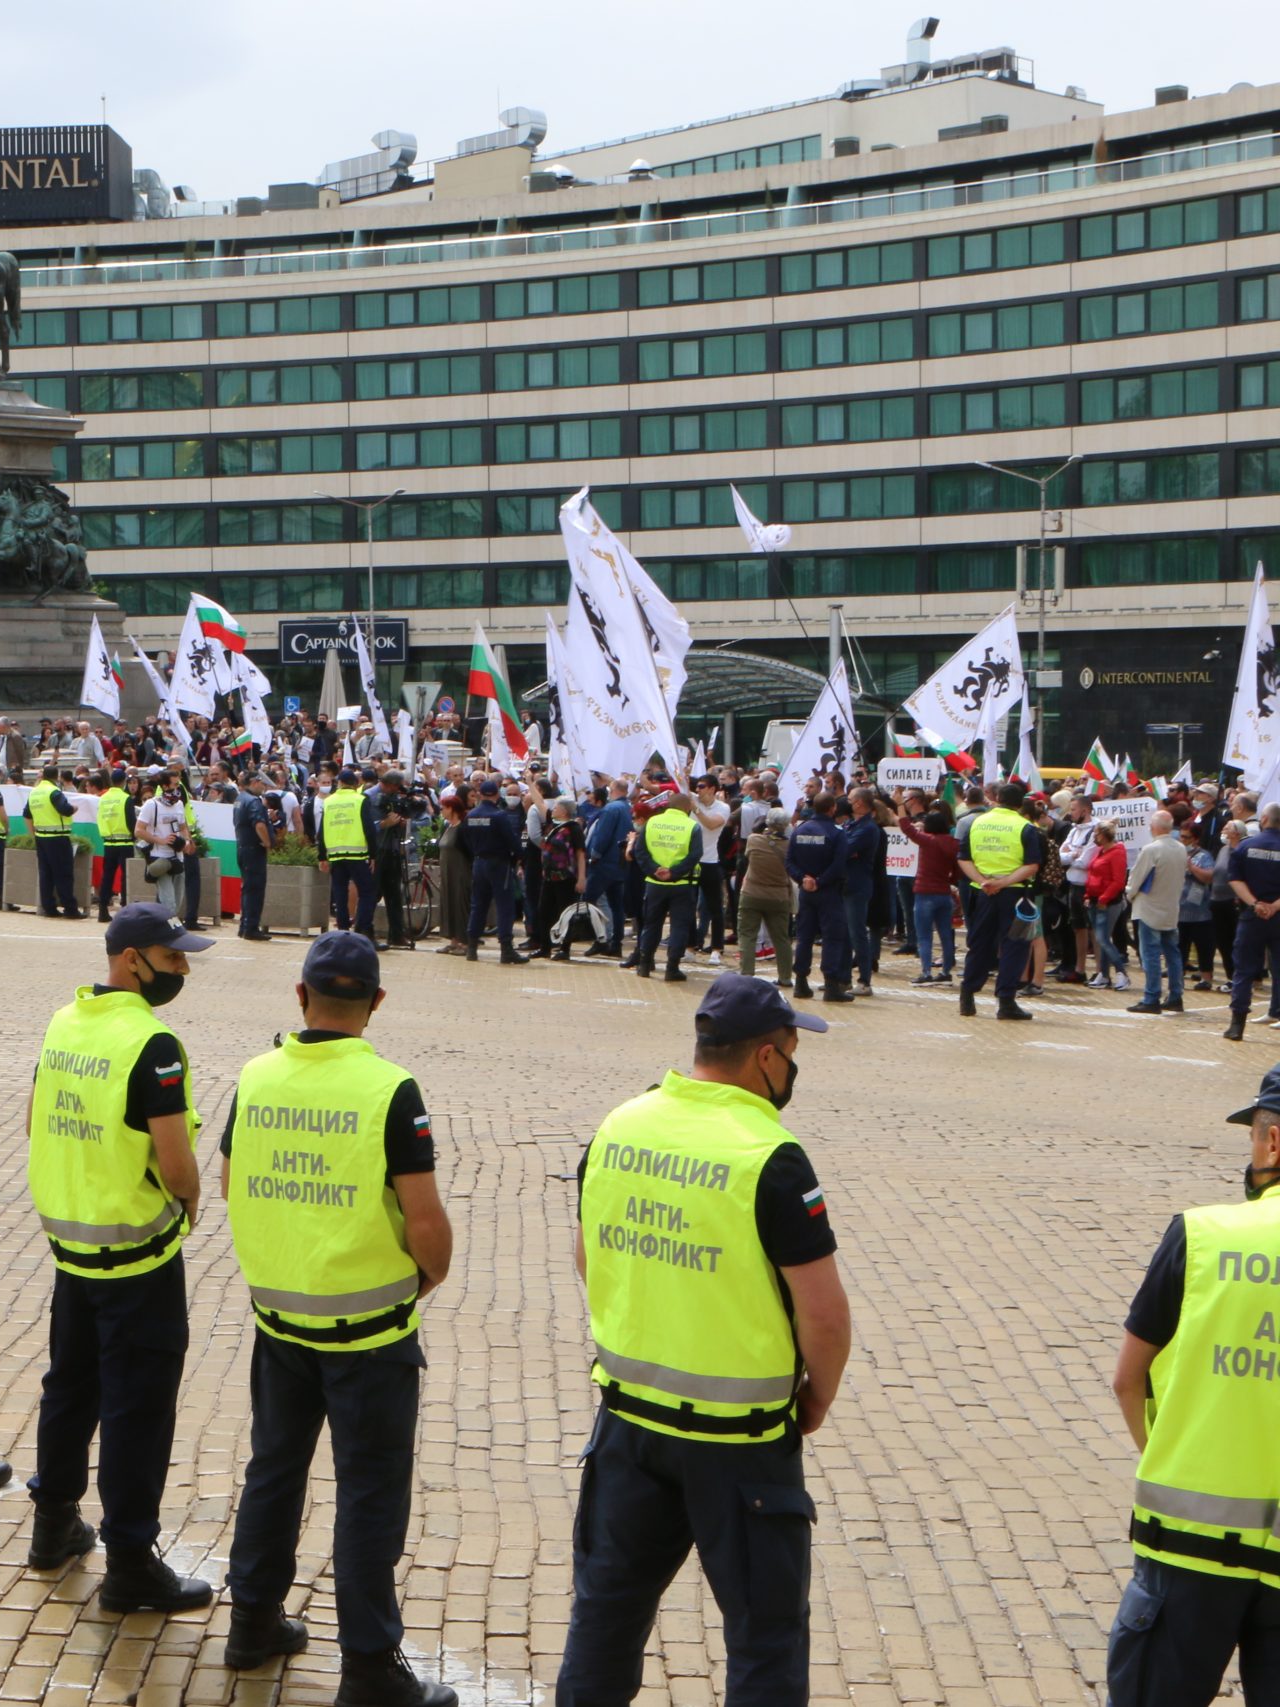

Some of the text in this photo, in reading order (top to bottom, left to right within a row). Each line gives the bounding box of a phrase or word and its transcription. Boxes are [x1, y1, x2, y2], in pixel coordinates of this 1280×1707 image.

[886, 769, 931, 780] СИЛАТА Е
[1091, 802, 1150, 817] ОЛУ РЪЦЕТЕ
[1118, 816, 1146, 828] ШИТЕ
[1117, 832, 1135, 842] ЦА!
[247, 1105, 359, 1137] ПОЛИЦИЯ
[272, 1149, 332, 1176] АНТИ-
[603, 1142, 731, 1192] ПОЛИЦИЯ
[247, 1175, 358, 1208] КОНФЛИКТ
[625, 1195, 690, 1233] АНТИ-
[599, 1223, 723, 1273] КОНФЛИКТ
